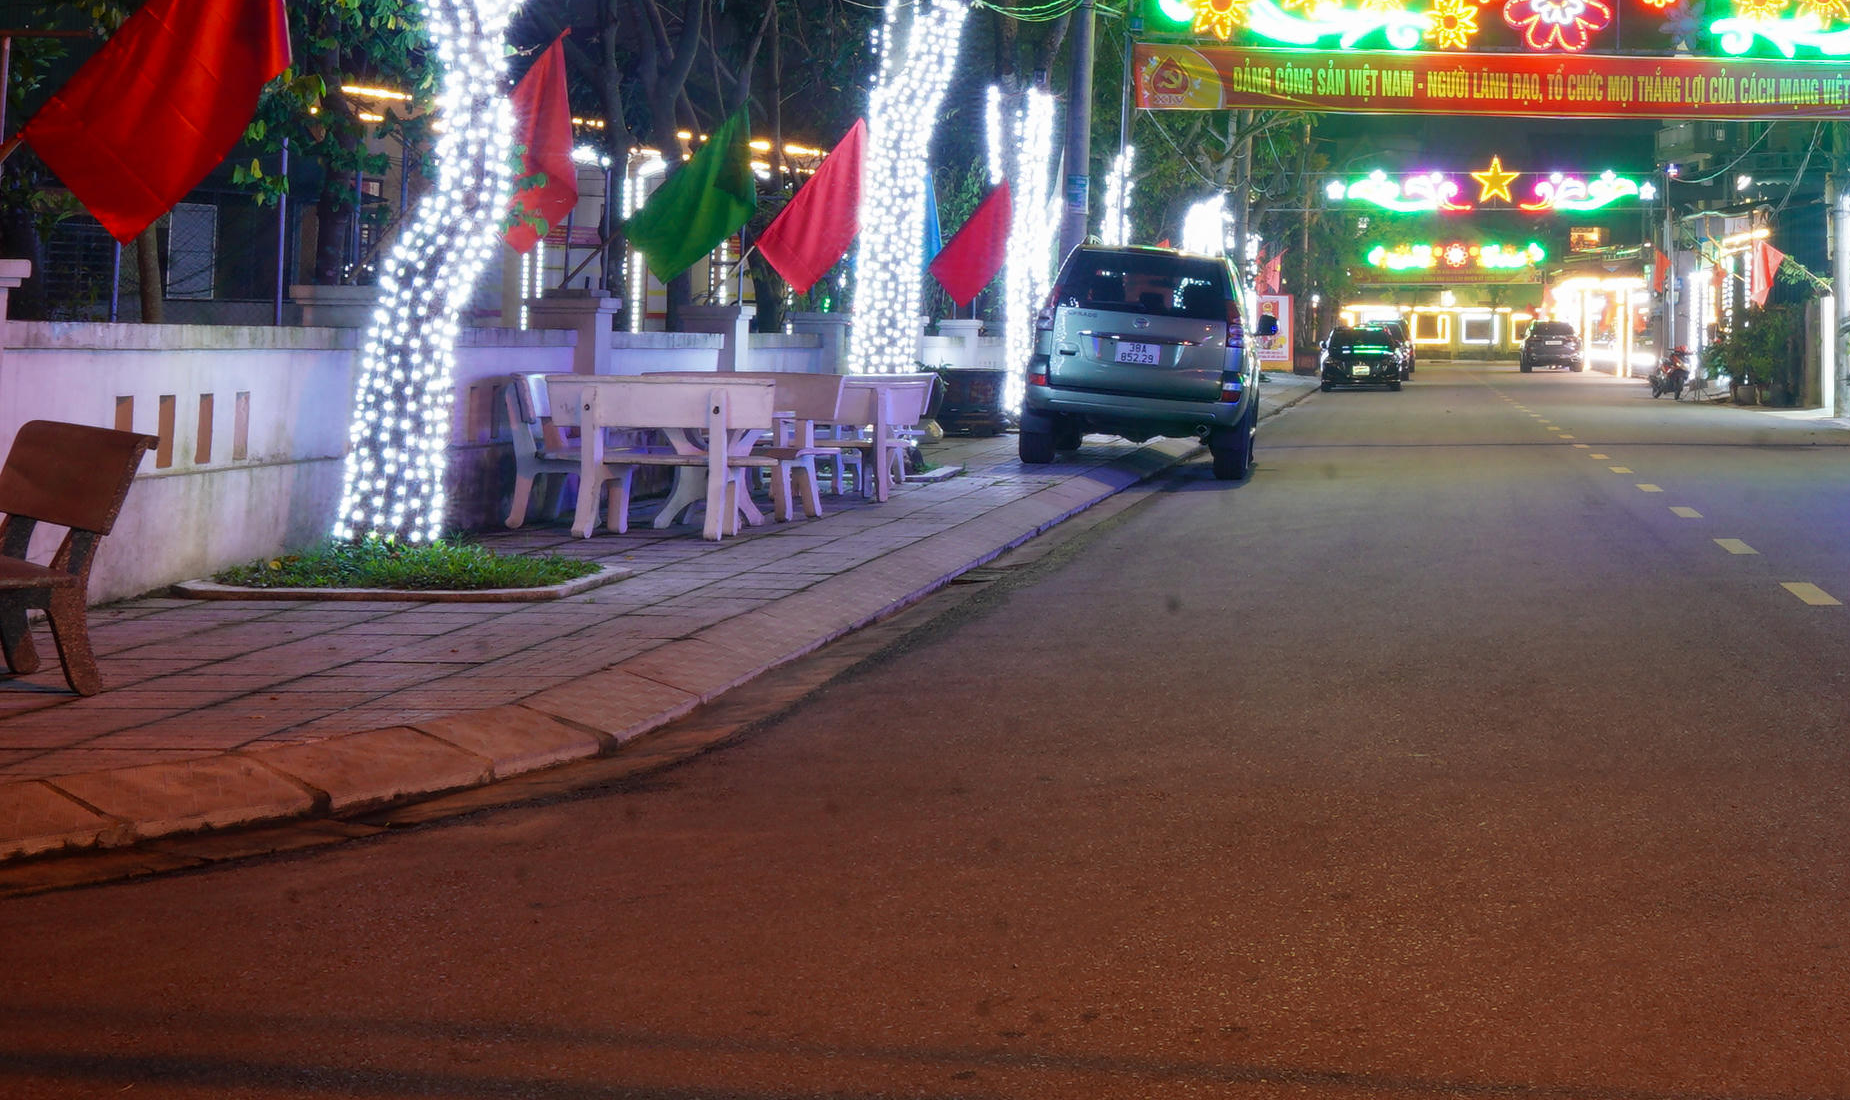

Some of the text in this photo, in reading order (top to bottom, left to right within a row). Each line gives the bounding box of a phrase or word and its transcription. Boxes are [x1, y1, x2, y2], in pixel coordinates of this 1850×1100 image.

[1233, 57, 1272, 93] ĐẢNG
[1275, 62, 1313, 99] CỘNG
[1317, 59, 1346, 96] SẢN
[1349, 63, 1379, 103] VIỆT
[1381, 70, 1414, 98] NAM
[1427, 65, 1469, 99] NGƯỜI
[1473, 67, 1509, 100] LÃNH
[1512, 73, 1544, 106] ĐẠO,
[1547, 63, 1565, 101] TỔ
[1567, 69, 1604, 101] CHỨC
[1607, 75, 1633, 107] MỌI
[1637, 66, 1681, 103] THẮNG
[1685, 74, 1707, 108] LỢI
[1709, 68, 1737, 104] CỦA
[1740, 72, 1776, 104] CÁCH
[1779, 78, 1819, 110] MẠNG
[1823, 73, 1850, 110] VIỆT
[1154, 95, 1185, 105] XIV
[1129, 343, 1147, 353] 38A
[1120, 352, 1154, 364] 852.29
